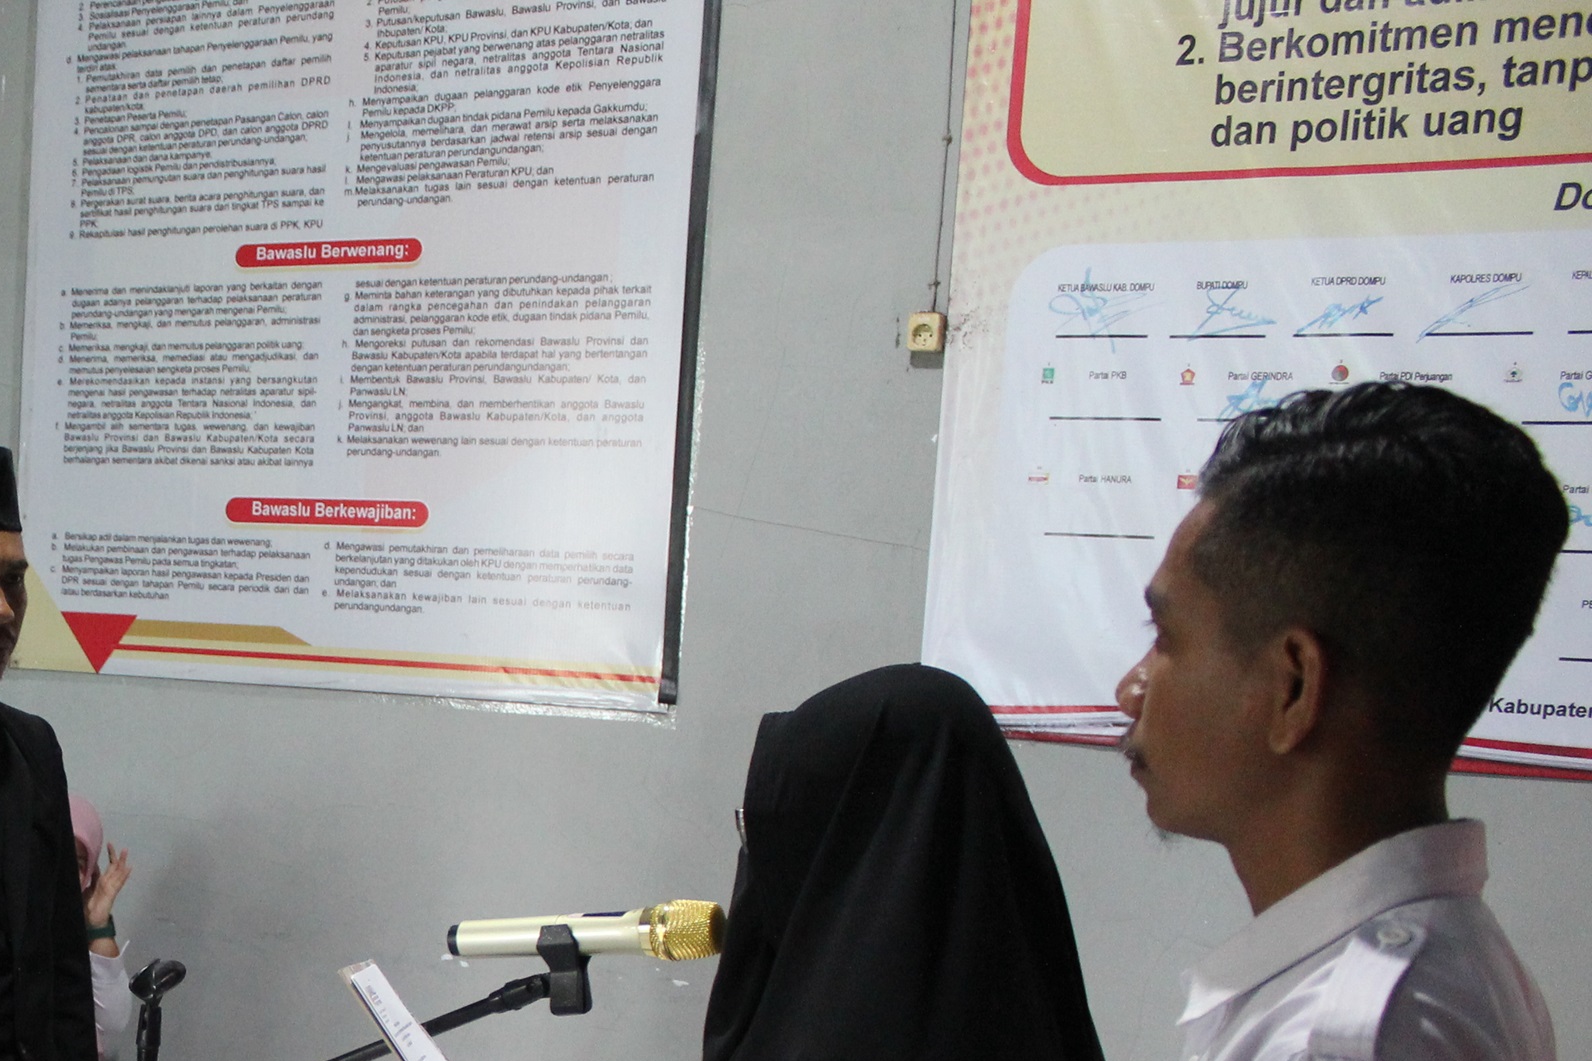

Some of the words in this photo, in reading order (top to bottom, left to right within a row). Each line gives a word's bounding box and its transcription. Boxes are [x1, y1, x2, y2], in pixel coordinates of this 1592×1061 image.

[1176, 34, 1205, 66] 2.
[1218, 20, 1478, 63] Berkomitmen
[1215, 62, 1486, 105] berintergritas,
[1211, 115, 1277, 147] dan
[1290, 107, 1409, 152] politik
[1423, 106, 1524, 141] uang
[256, 245, 316, 260] Bawaslu
[321, 244, 409, 259] Berwenang:
[1311, 277, 1336, 286] KETUA
[1336, 277, 1357, 286] DPRD
[1358, 276, 1386, 286] DOMPU
[1450, 273, 1492, 284] KAPOLRES
[1493, 272, 1522, 283] DOMPU
[1058, 284, 1079, 293] KETUA
[1080, 283, 1112, 292] BAWASLU
[1129, 283, 1155, 292] DOMPU
[1196, 281, 1220, 290] BUPATI
[1221, 281, 1248, 290] DOMPU
[1089, 371, 1108, 380] Partai
[1111, 371, 1127, 380] PKB
[1227, 372, 1249, 381] Partai
[1250, 372, 1293, 381] GERINDRA
[1380, 372, 1401, 381] Partai
[1414, 372, 1453, 382] Perjuangan
[1560, 371, 1583, 380] Partai
[1101, 475, 1132, 483] HANURA
[1563, 485, 1589, 494] Partai
[252, 501, 310, 517] Bawaslu
[315, 502, 416, 523] Berkewajiban:
